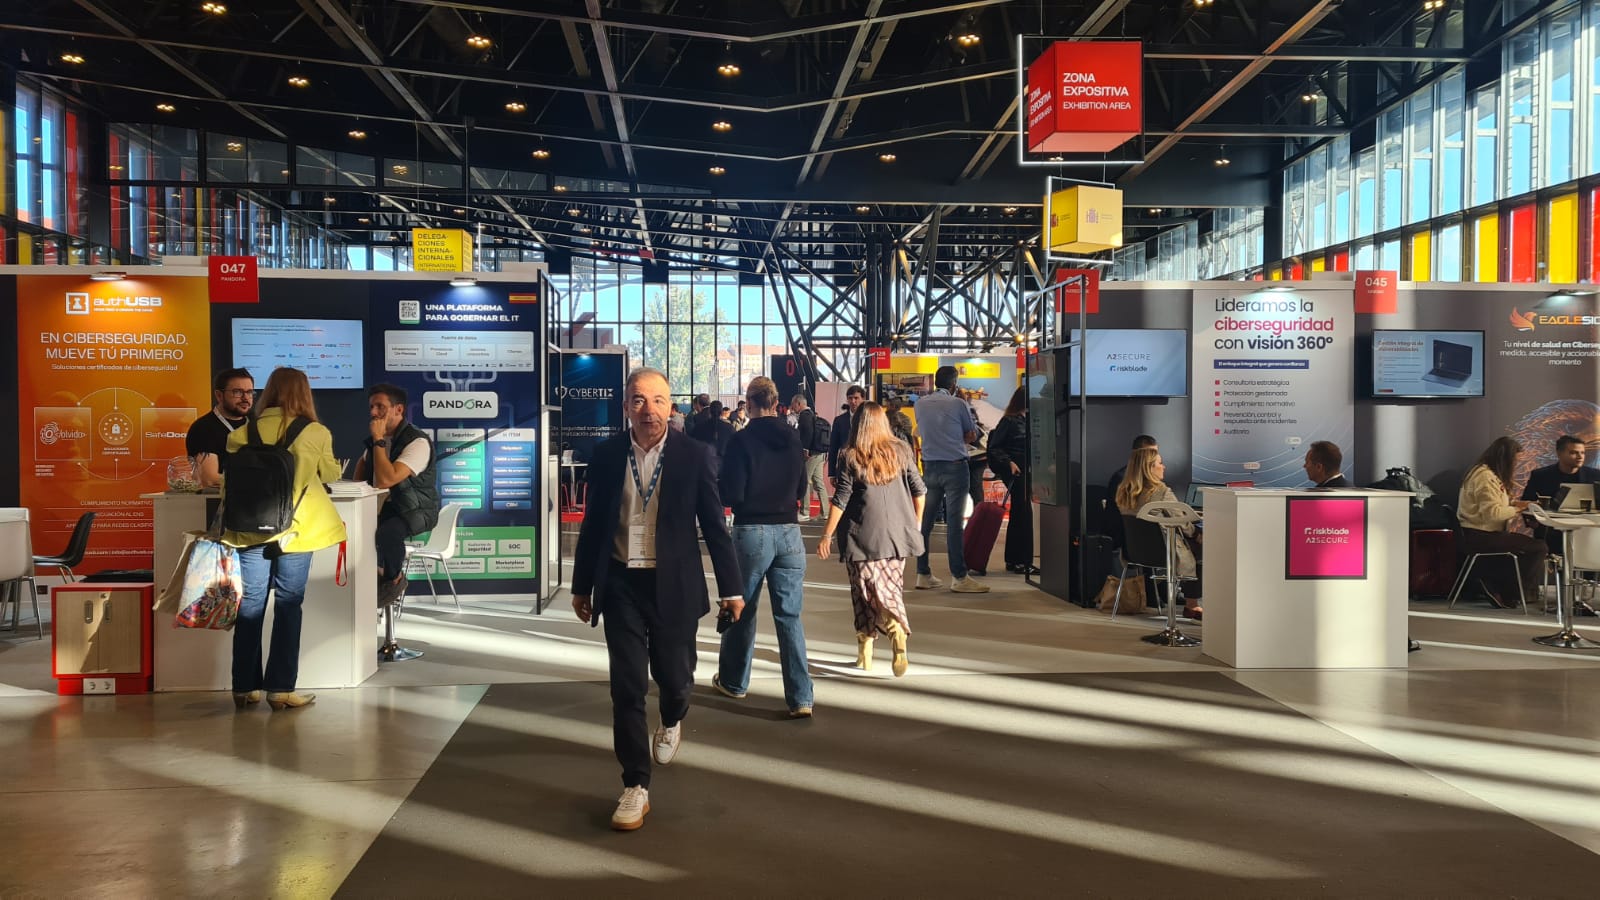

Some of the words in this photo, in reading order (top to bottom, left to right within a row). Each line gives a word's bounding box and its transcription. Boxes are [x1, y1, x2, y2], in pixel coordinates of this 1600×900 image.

[1063, 73, 1096, 83] ZONA
[1063, 86, 1129, 96] EXPOSITIVA
[220, 263, 246, 274] 047
[1365, 277, 1388, 287] 045
[446, 304, 503, 312] PLATAFORMA
[1215, 298, 1297, 312] Lideramos
[1300, 298, 1314, 312] la
[450, 314, 498, 322] GOBERNAR
[1214, 316, 1334, 336] ciberseguridad
[40, 332, 59, 343] EN
[1214, 338, 1244, 350] con
[1248, 335, 1294, 350] visión
[46, 348, 95, 359] MUEVE
[99, 346, 117, 359] TÚ
[120, 349, 184, 360] PRIMERO
[1106, 353, 1152, 361] A2SECURE
[569, 387, 614, 397] CYBERTIX
[429, 398, 492, 410] PANDORA
[1312, 527, 1350, 535] riskblade
[1305, 536, 1349, 544] A2SECURE
